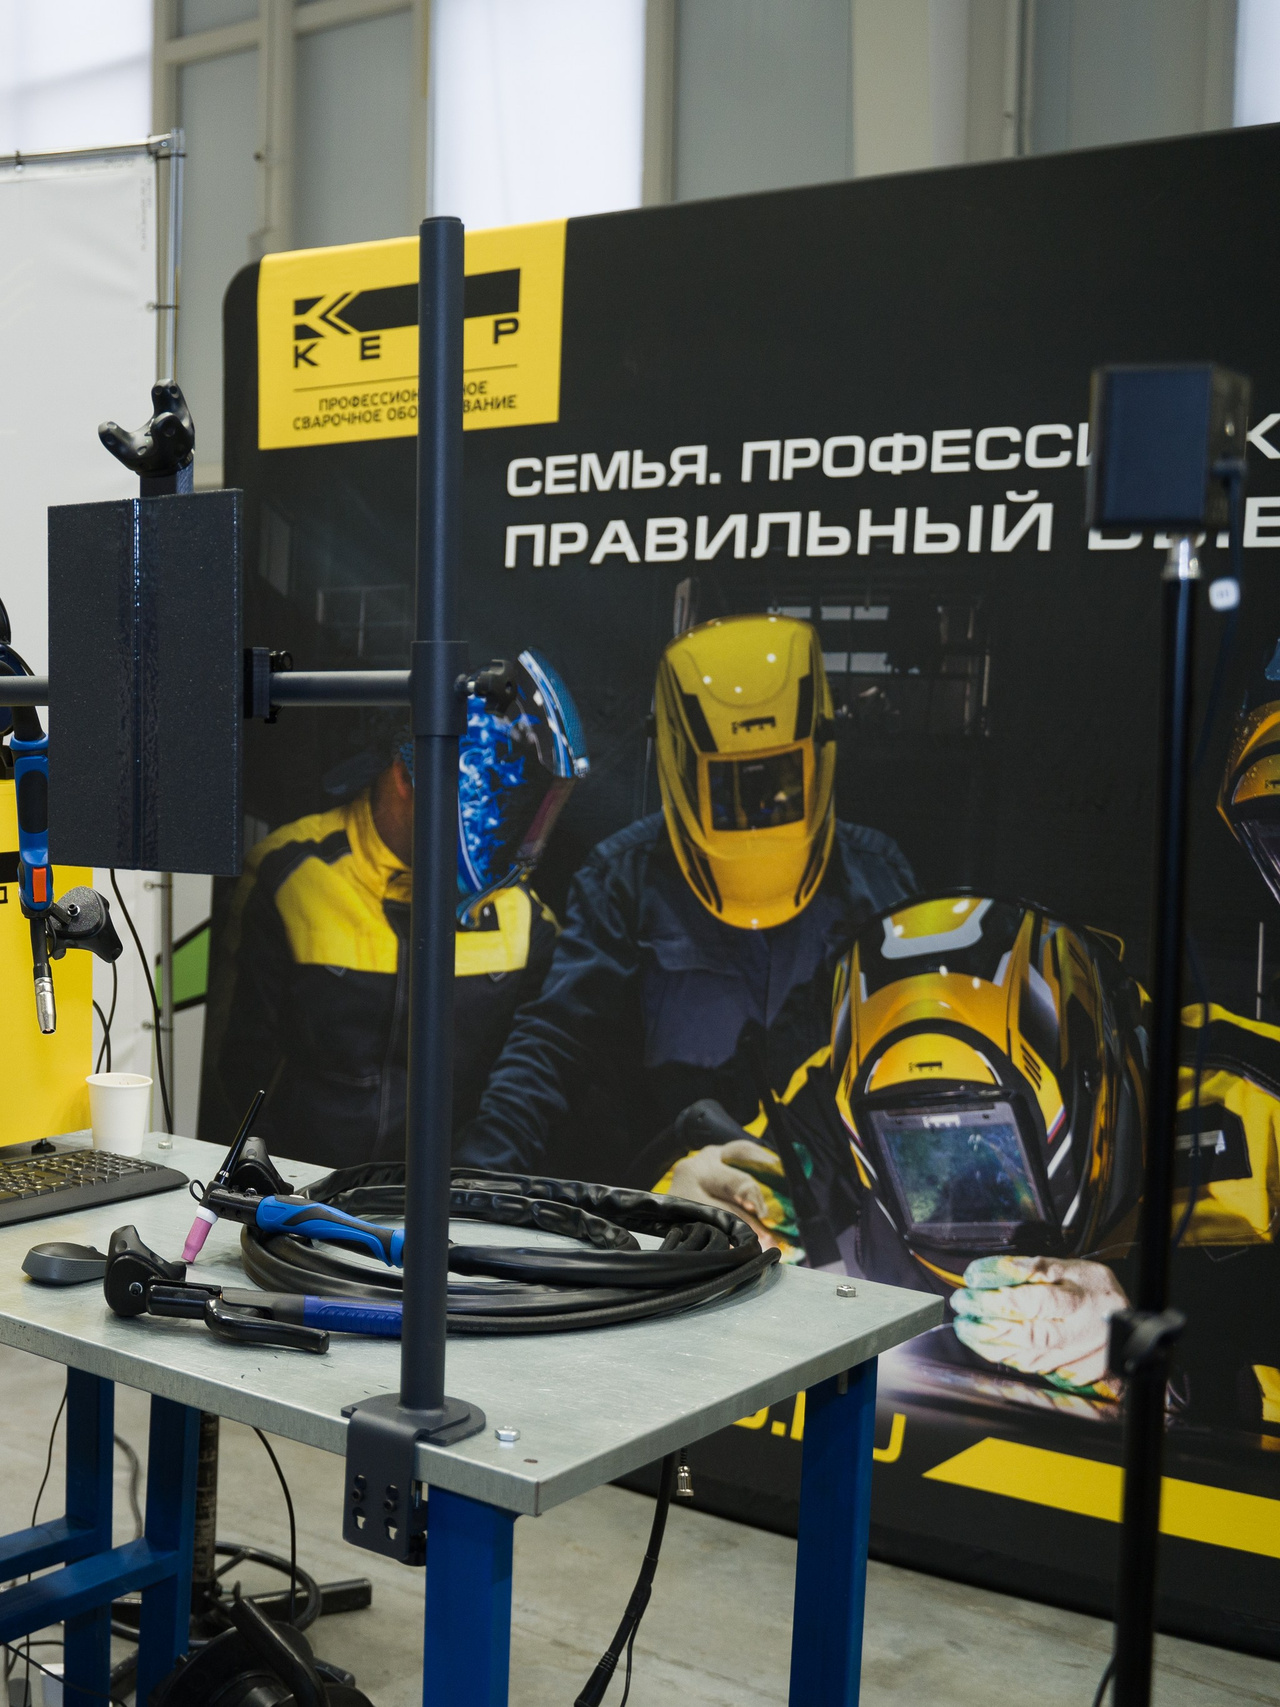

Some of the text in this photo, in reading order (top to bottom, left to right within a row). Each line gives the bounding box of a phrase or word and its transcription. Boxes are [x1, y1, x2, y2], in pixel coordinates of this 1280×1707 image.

[293, 317, 520, 369] КЕР
[292, 394, 517, 431] СВАРОЧНОЕ ОБОВАНИЕ
[506, 444, 721, 498] СЕМЬЯ.
[504, 489, 1054, 569] ПРАВИЛЬНЫЙ
